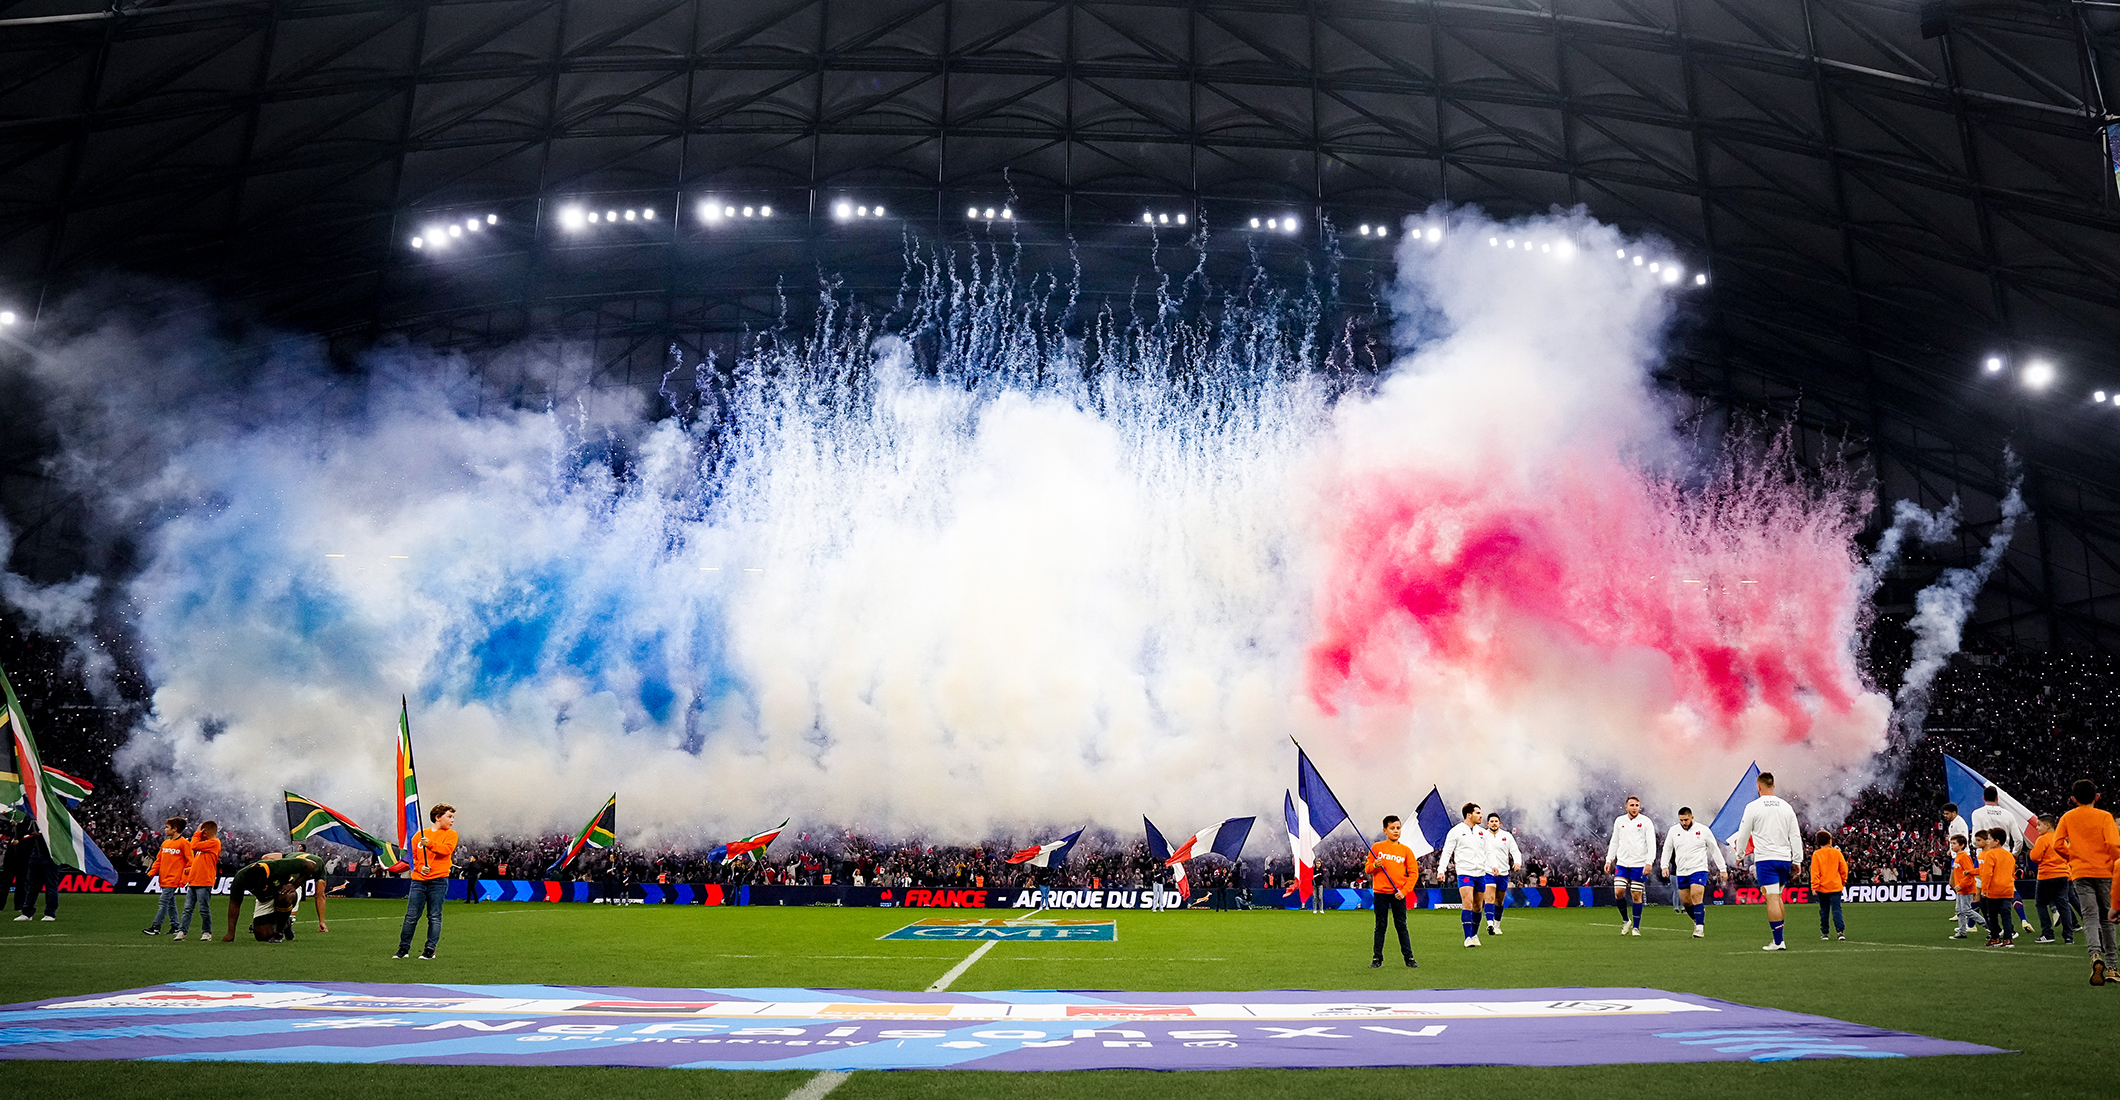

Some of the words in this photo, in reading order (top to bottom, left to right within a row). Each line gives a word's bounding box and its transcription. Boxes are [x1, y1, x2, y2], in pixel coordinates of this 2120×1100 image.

[1378, 851, 1405, 863] Orange
[904, 889, 988, 908] FRANCE
[1106, 890, 1137, 908] DU
[1735, 887, 1810, 904] FRCE
[1916, 884, 1942, 901] DU
[913, 927, 1100, 938] GMF
